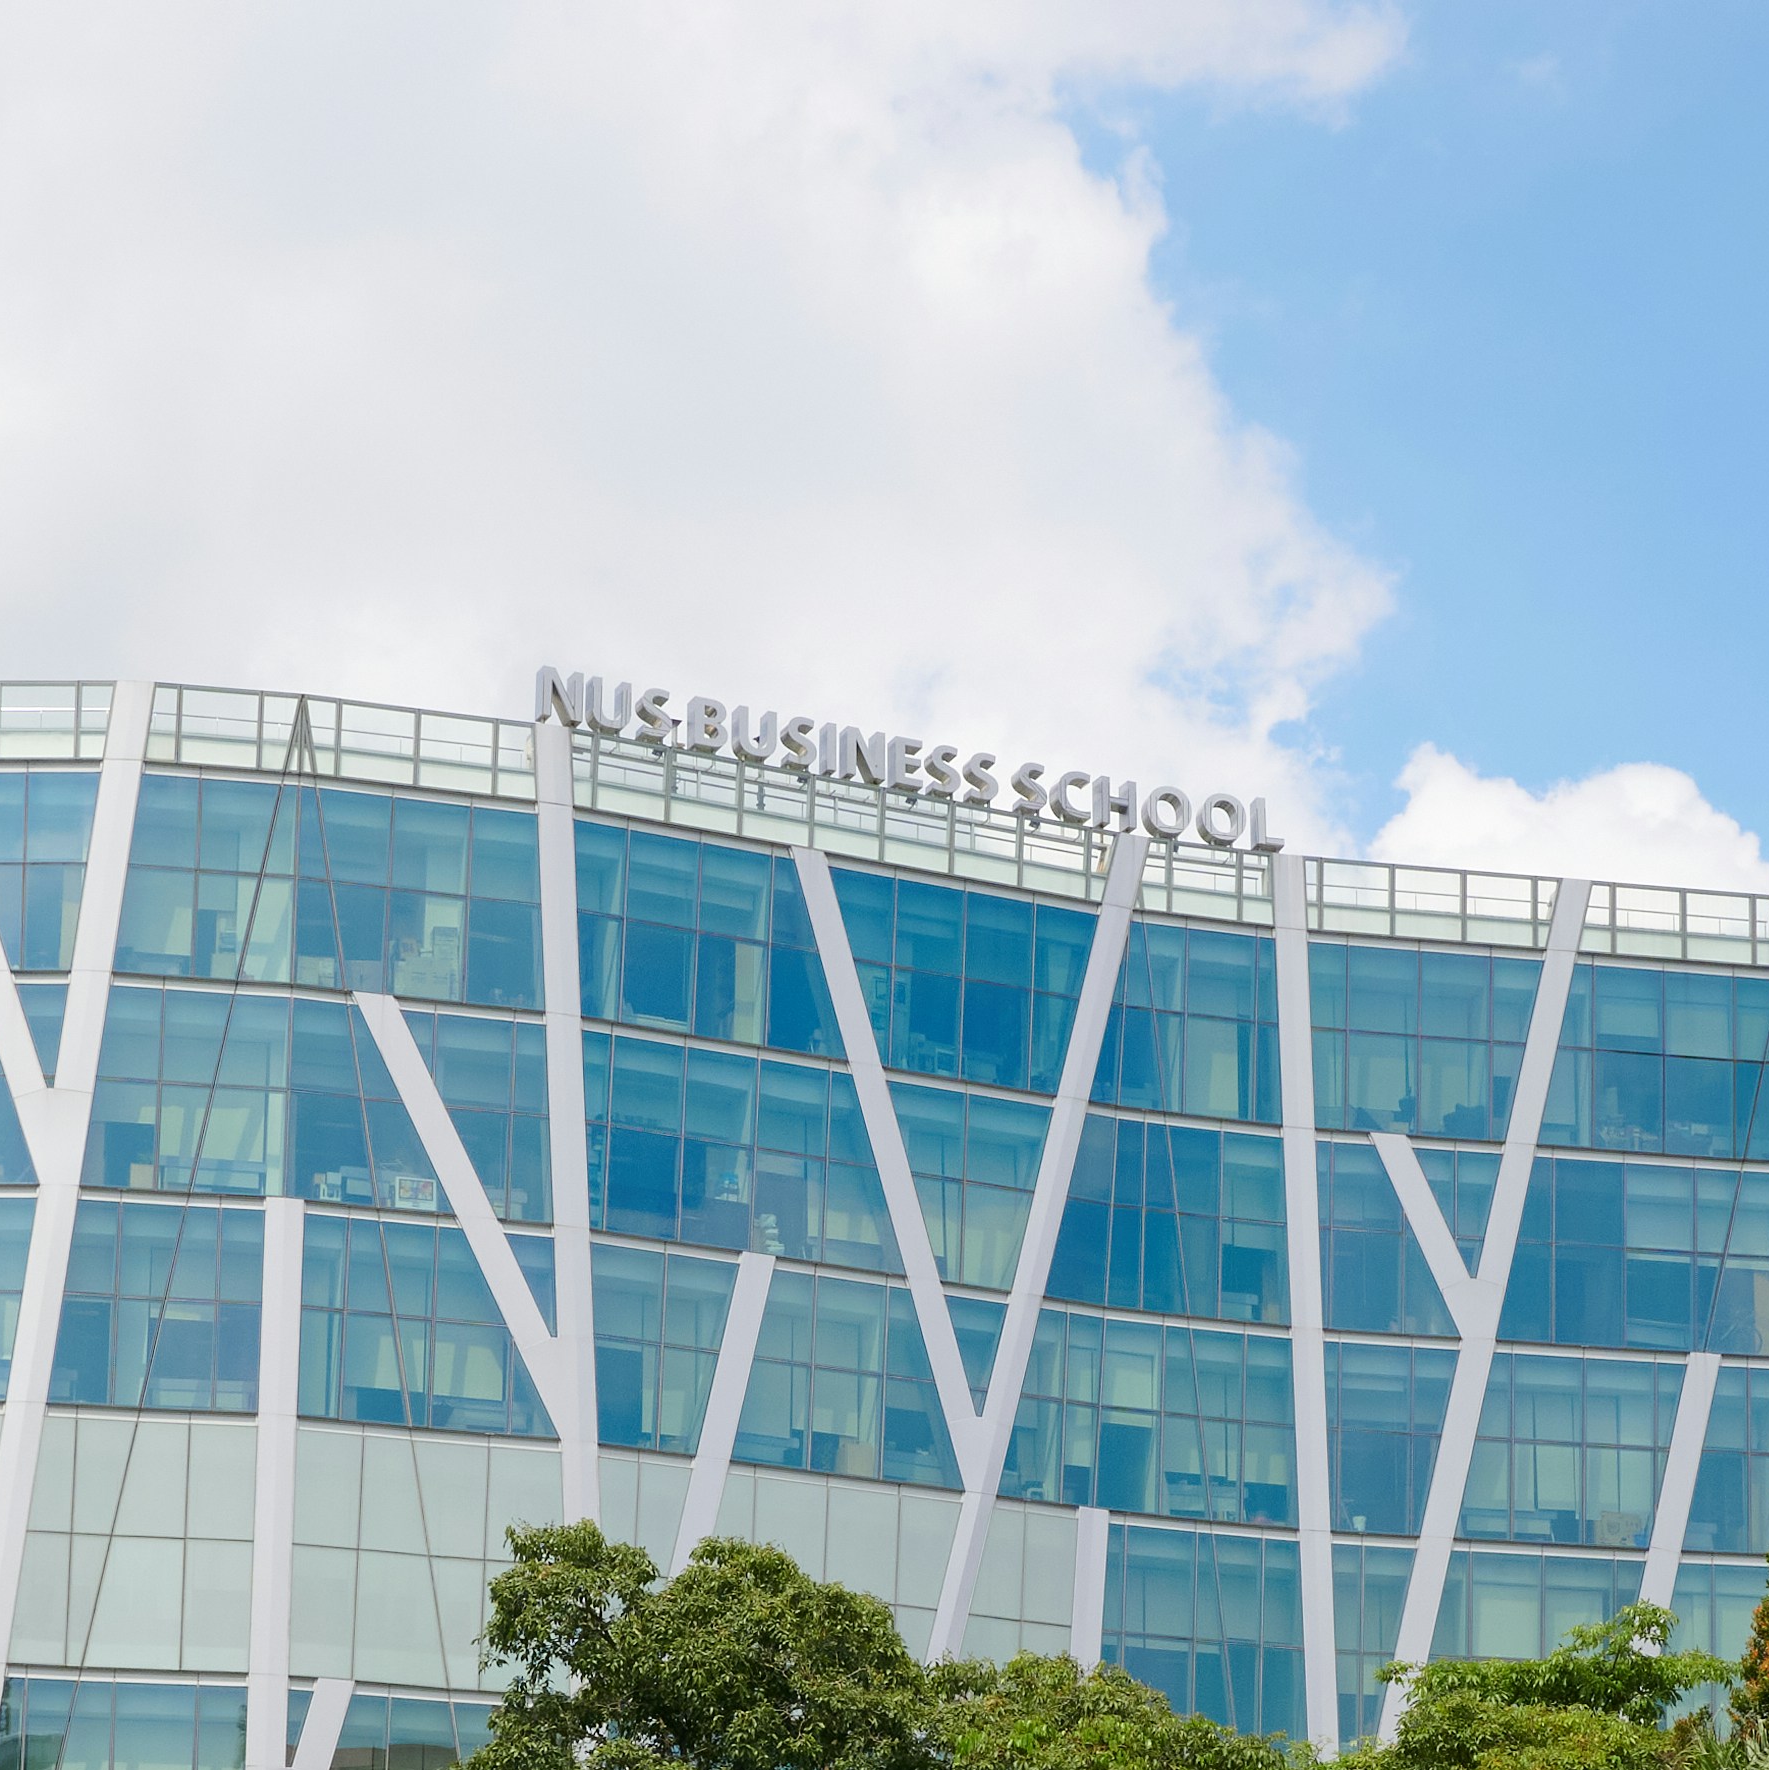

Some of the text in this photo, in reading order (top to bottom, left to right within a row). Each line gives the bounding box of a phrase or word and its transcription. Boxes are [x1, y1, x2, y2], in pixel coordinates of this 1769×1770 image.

[535, 665, 1285, 851] NUS BUSINESS SCHOOL
